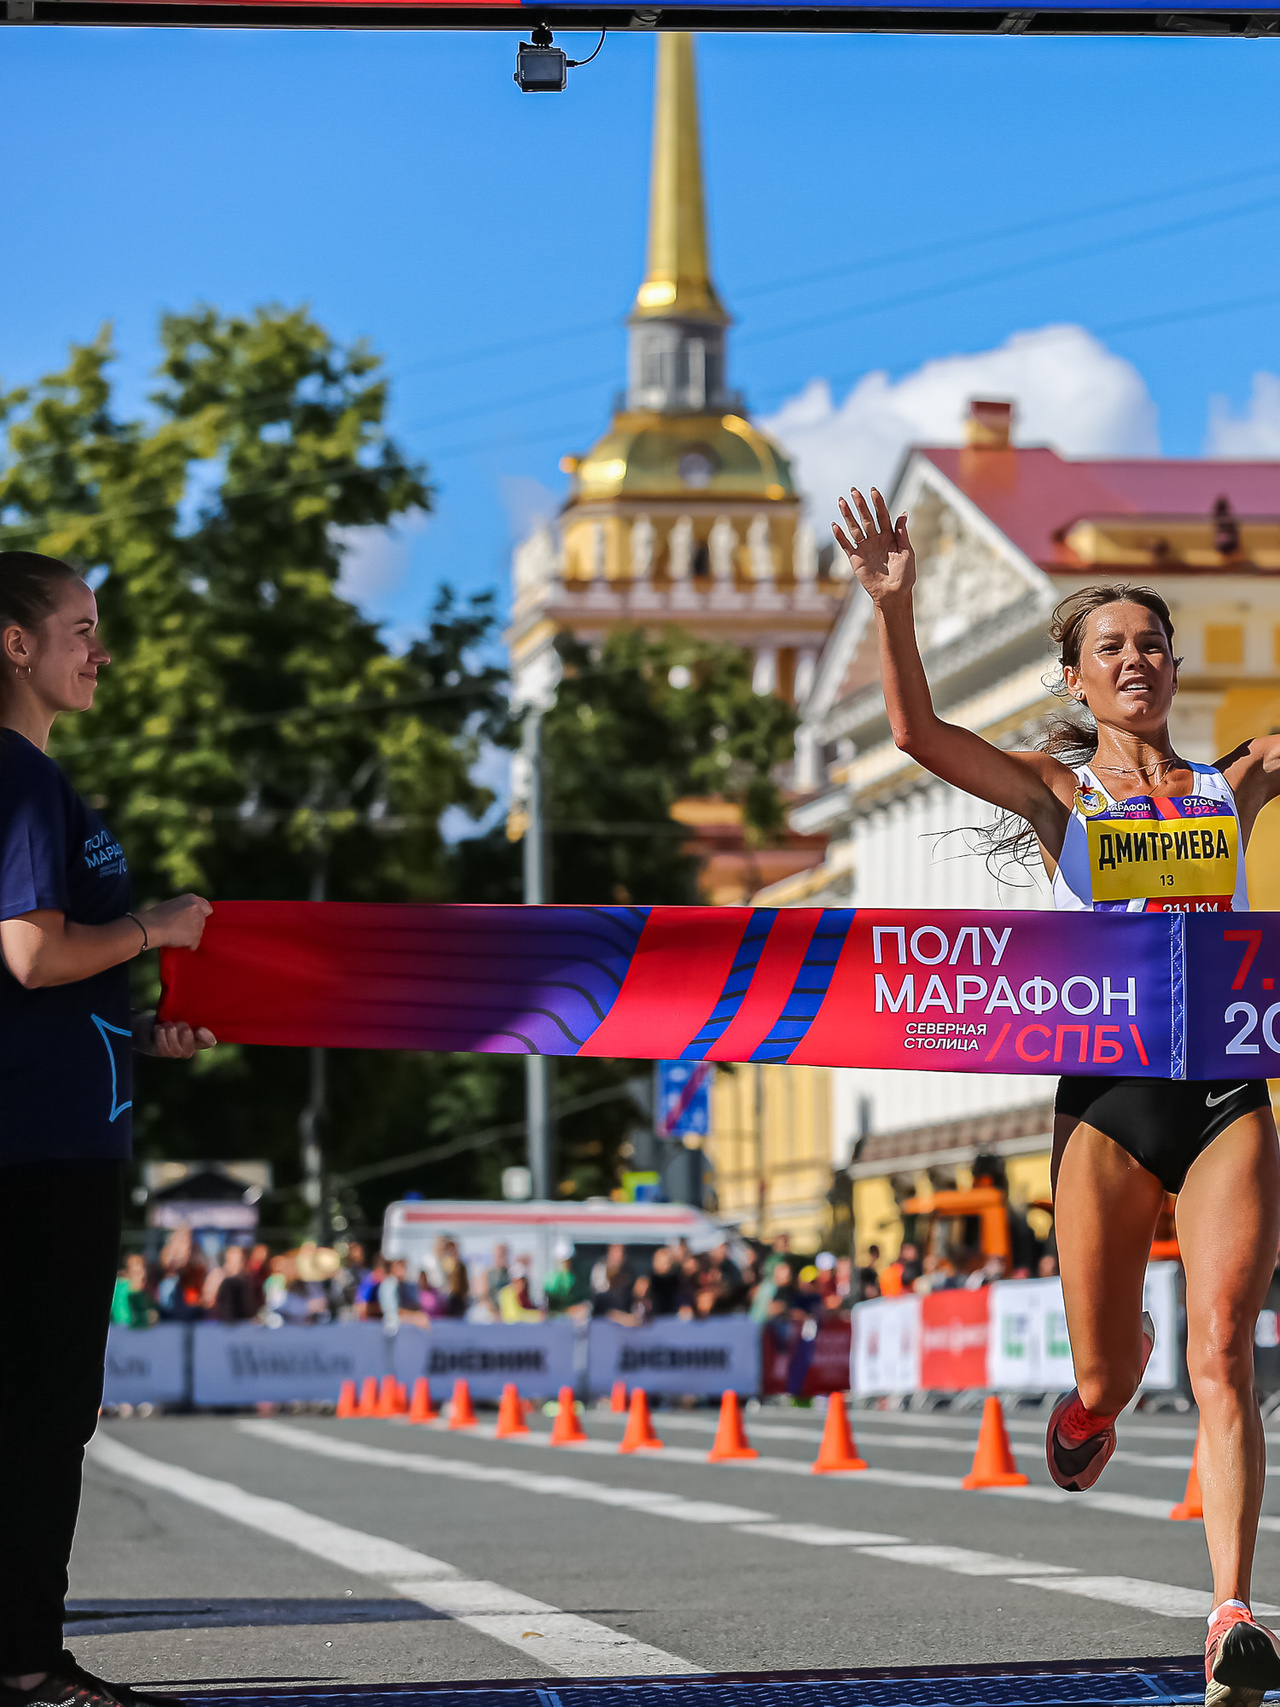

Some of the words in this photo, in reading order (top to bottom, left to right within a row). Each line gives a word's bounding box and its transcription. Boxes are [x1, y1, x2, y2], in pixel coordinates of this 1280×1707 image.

[1185, 806, 1218, 815] 2022
[84, 830, 111, 853] ПОЛ
[1098, 829, 1230, 871] ДМИТРИЕВА
[1159, 874, 1175, 887] 13
[872, 925, 1013, 966] ПОЛУ
[874, 973, 1137, 1017] МАРАФОН
[905, 1022, 987, 1036] СЕВЕРНАЯ
[903, 1037, 980, 1052] СТОЛИЦА
